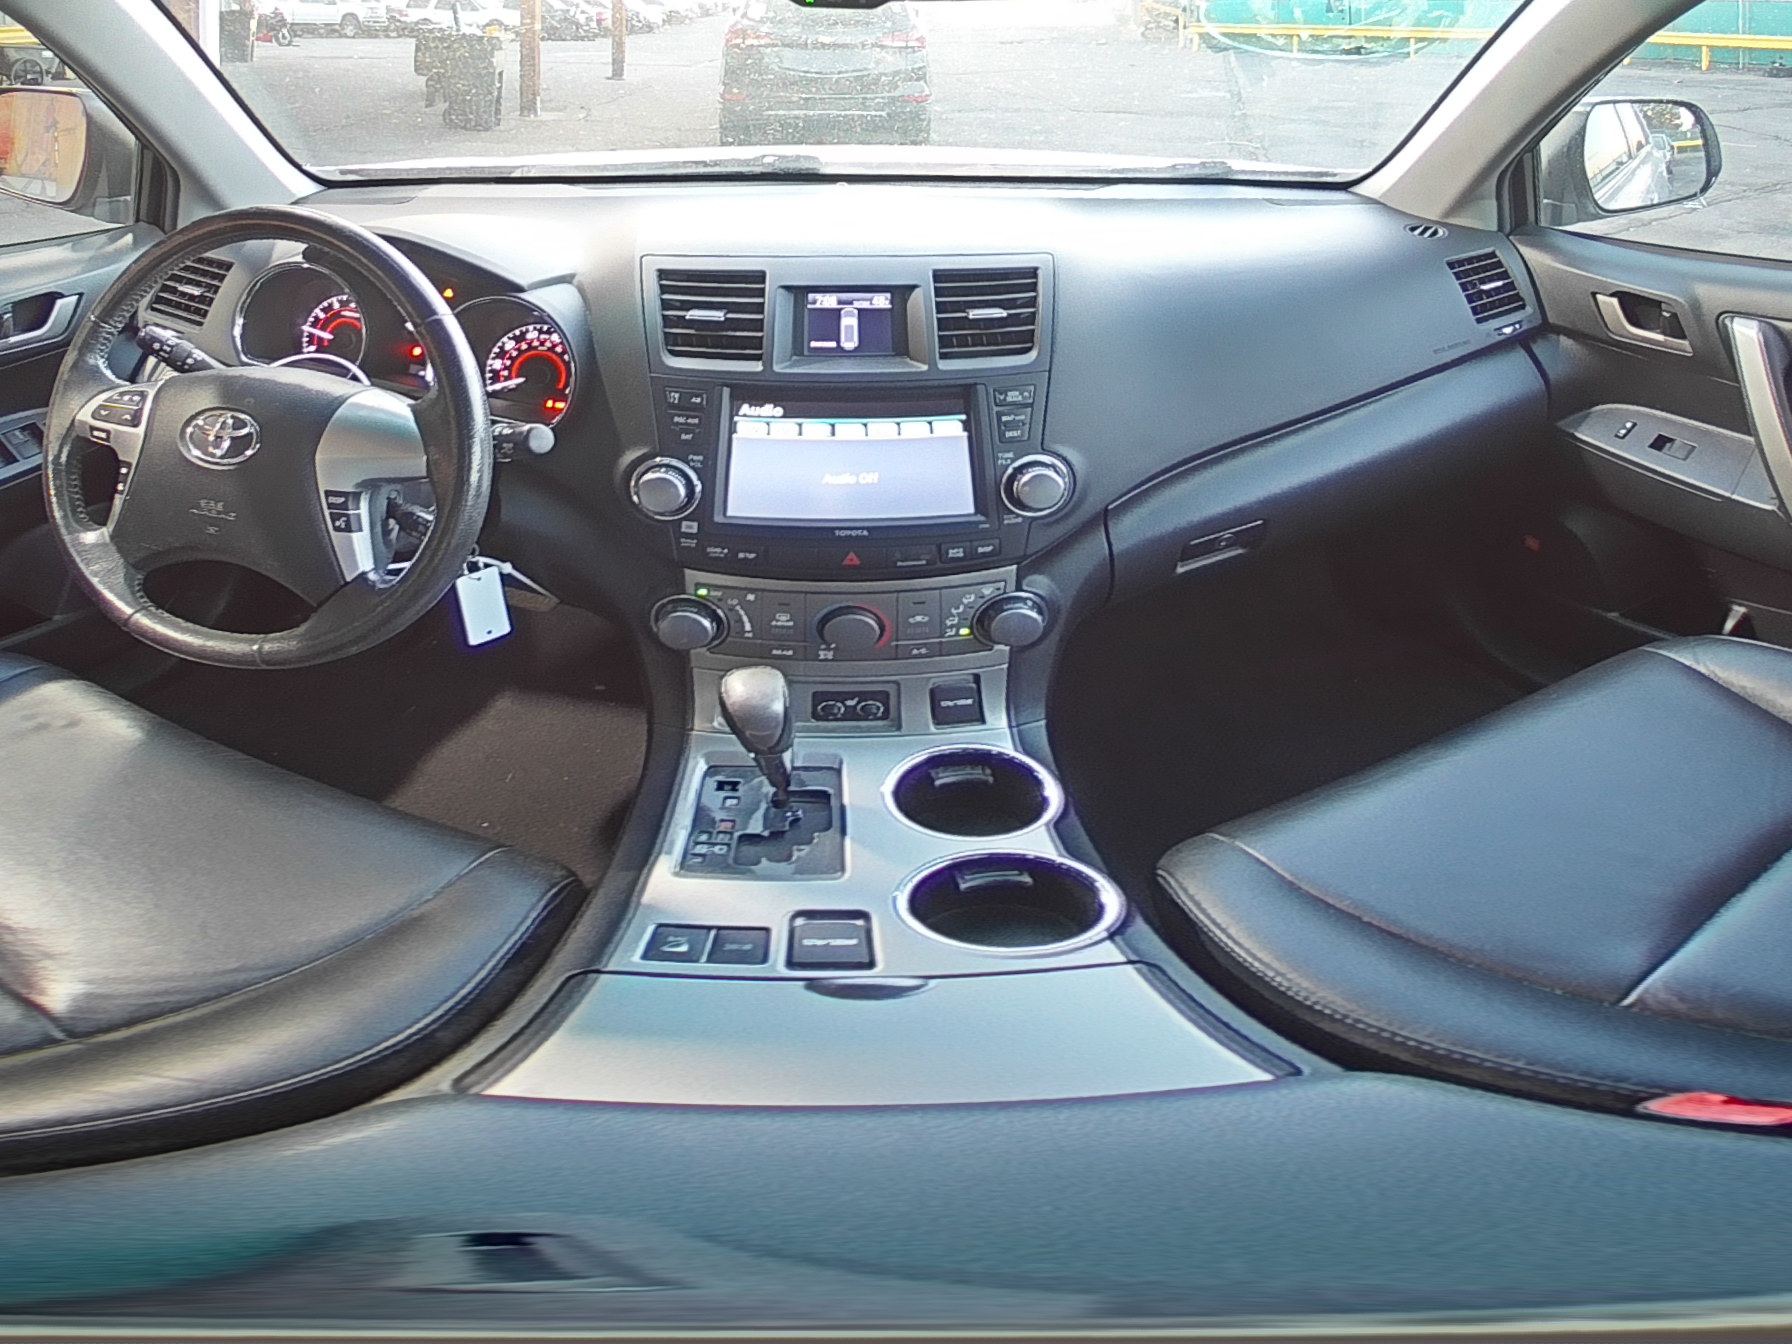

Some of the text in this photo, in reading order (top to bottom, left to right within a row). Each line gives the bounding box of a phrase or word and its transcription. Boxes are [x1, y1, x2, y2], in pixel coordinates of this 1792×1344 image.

[738, 403, 785, 417] Audio
[821, 472, 879, 485] Audio Off
[833, 529, 870, 537] TOYOTA
